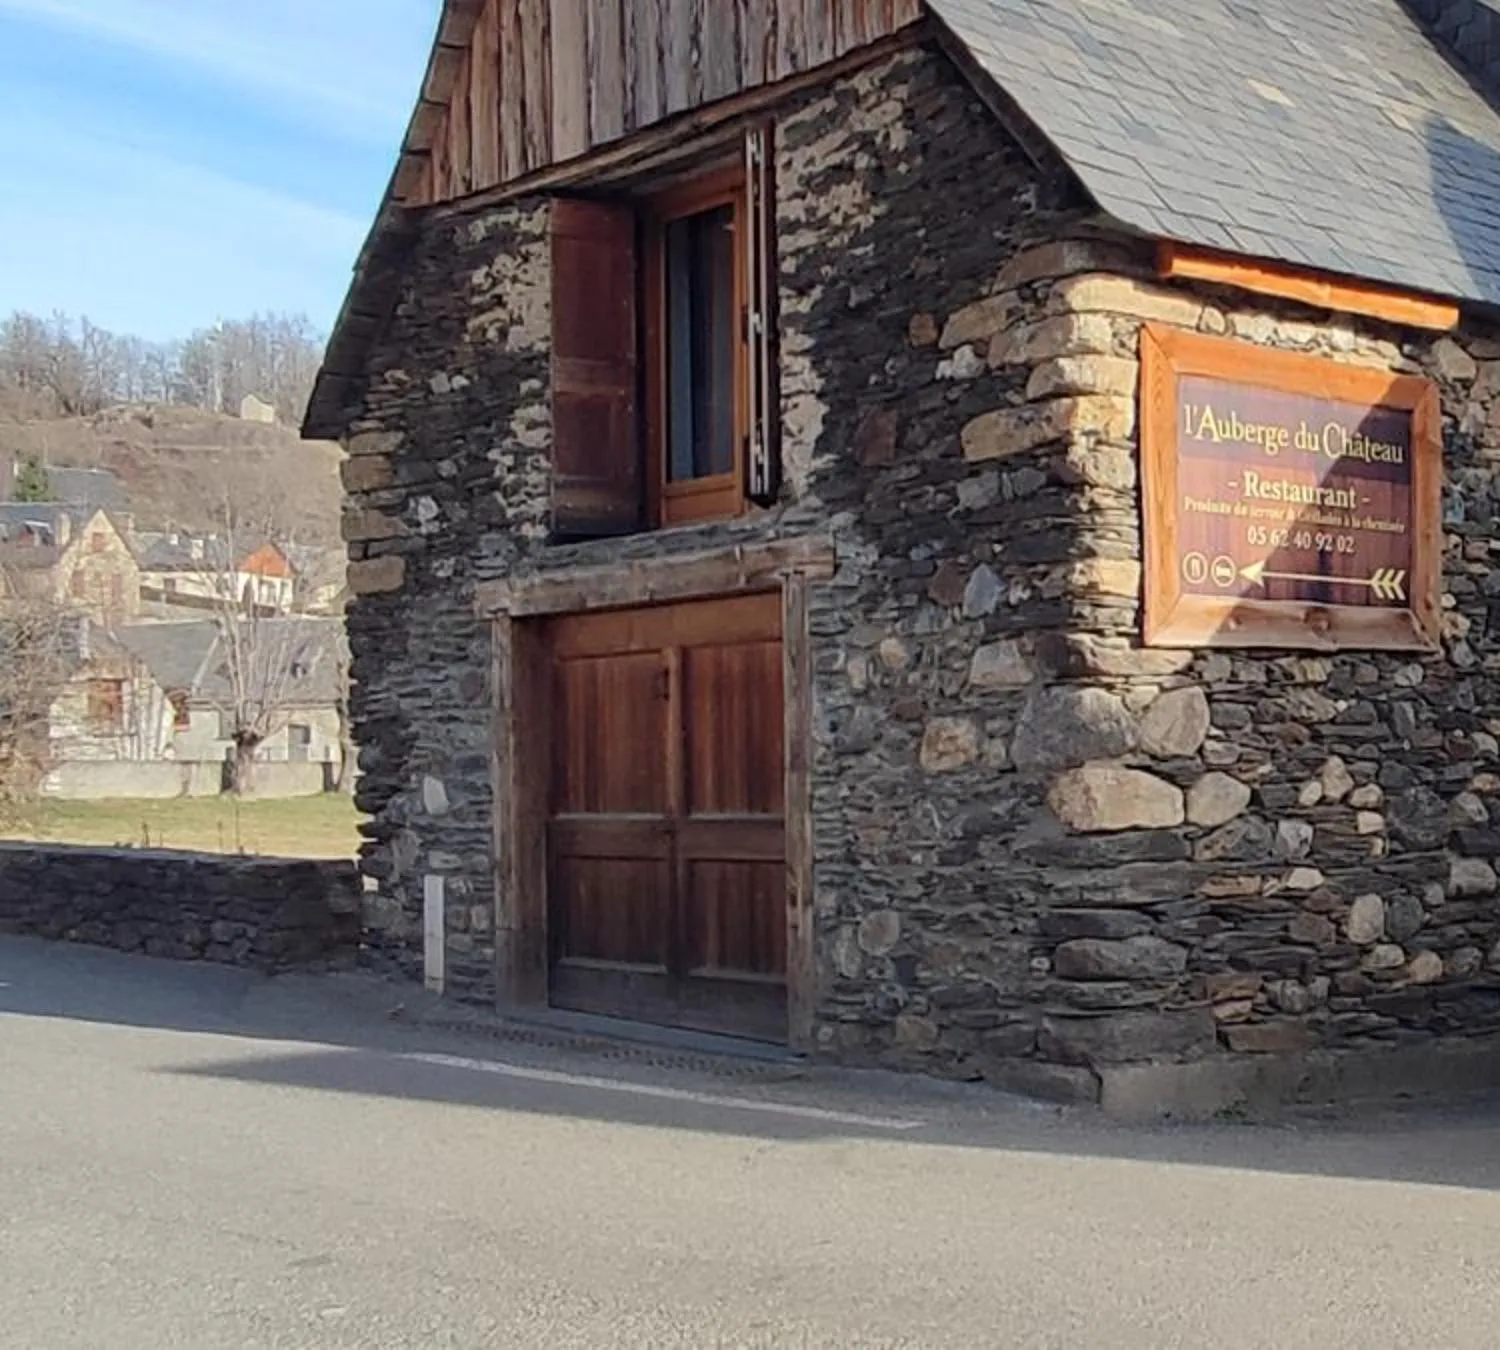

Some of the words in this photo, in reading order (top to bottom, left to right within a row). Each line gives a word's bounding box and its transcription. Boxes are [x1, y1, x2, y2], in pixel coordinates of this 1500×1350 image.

[1183, 403, 1290, 457] l'Auberge
[1293, 419, 1321, 451] du
[1322, 421, 1404, 464] Château
[1243, 469, 1357, 510] Restaurant
[1247, 525, 1267, 545] 05
[1269, 528, 1290, 548] 62
[1293, 530, 1312, 550] 40
[1315, 532, 1334, 551] 92
[1337, 535, 1355, 553] 02
